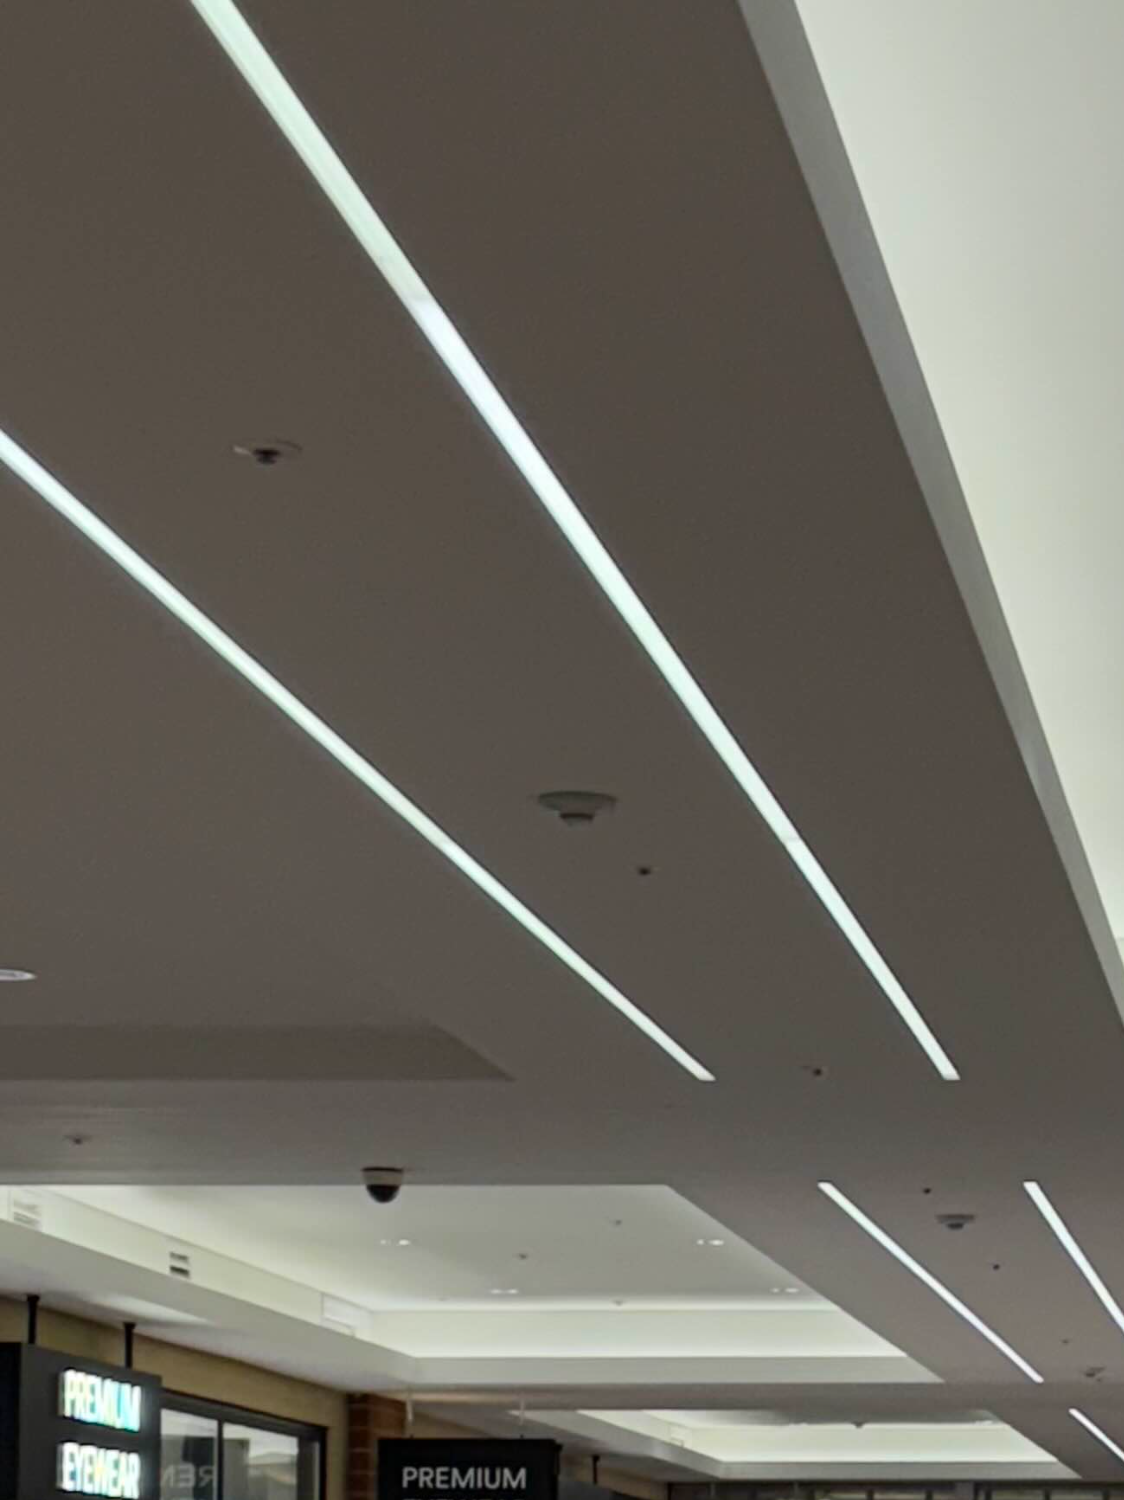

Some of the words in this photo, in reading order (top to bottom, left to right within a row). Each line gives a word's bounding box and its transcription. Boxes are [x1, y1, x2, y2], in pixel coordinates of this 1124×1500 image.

[62, 1369, 142, 1432] PREMIUM
[61, 1441, 141, 1500] EYEWEAR
[401, 1467, 528, 1489] PREMIUM
